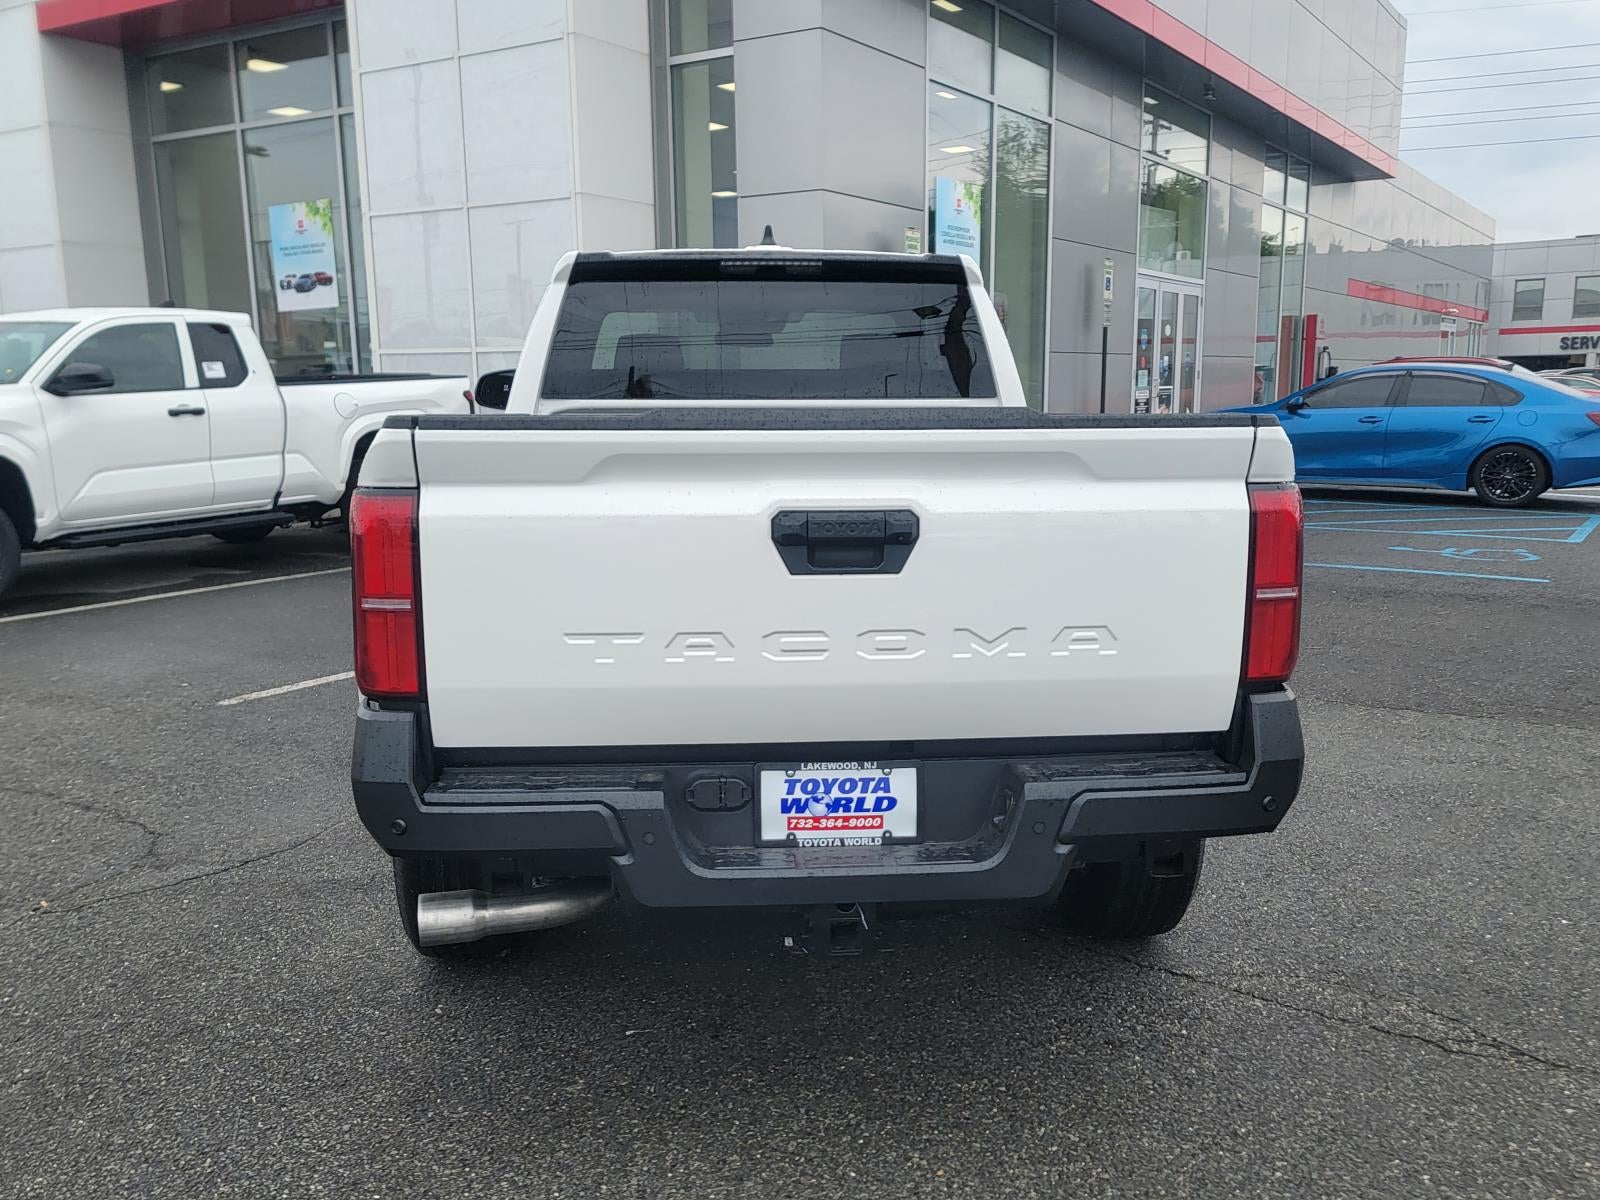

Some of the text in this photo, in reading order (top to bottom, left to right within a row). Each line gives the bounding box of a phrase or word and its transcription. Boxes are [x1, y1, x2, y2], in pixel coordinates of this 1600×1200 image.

[811, 520, 881, 536] TOYOTA
[563, 625, 1118, 664] TACOMA
[801, 761, 878, 771] LAKEWOOD, NJ
[784, 777, 891, 795] TOYOTA
[789, 817, 882, 829] 732-364-9000
[797, 836, 882, 847] TOYOTA WORLD
